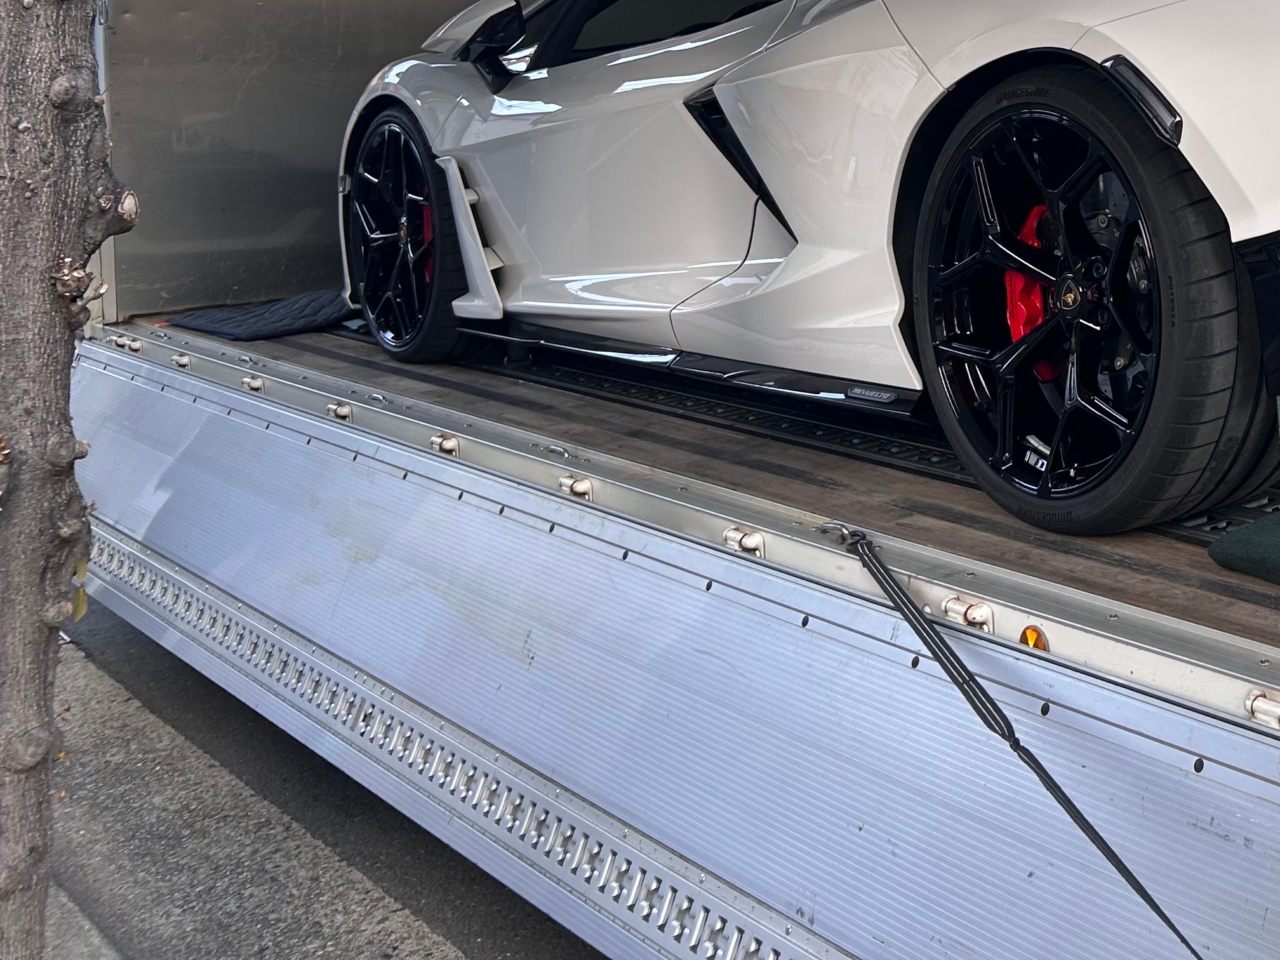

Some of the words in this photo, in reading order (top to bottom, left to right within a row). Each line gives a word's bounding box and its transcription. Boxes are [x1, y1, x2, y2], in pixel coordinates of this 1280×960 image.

[996, 87, 1051, 105] BRIDGESTONE
[1168, 275, 1176, 328] POTENZA
[851, 387, 892, 399] REVUELTO
[1017, 505, 1073, 522] BRIDGESTONE
